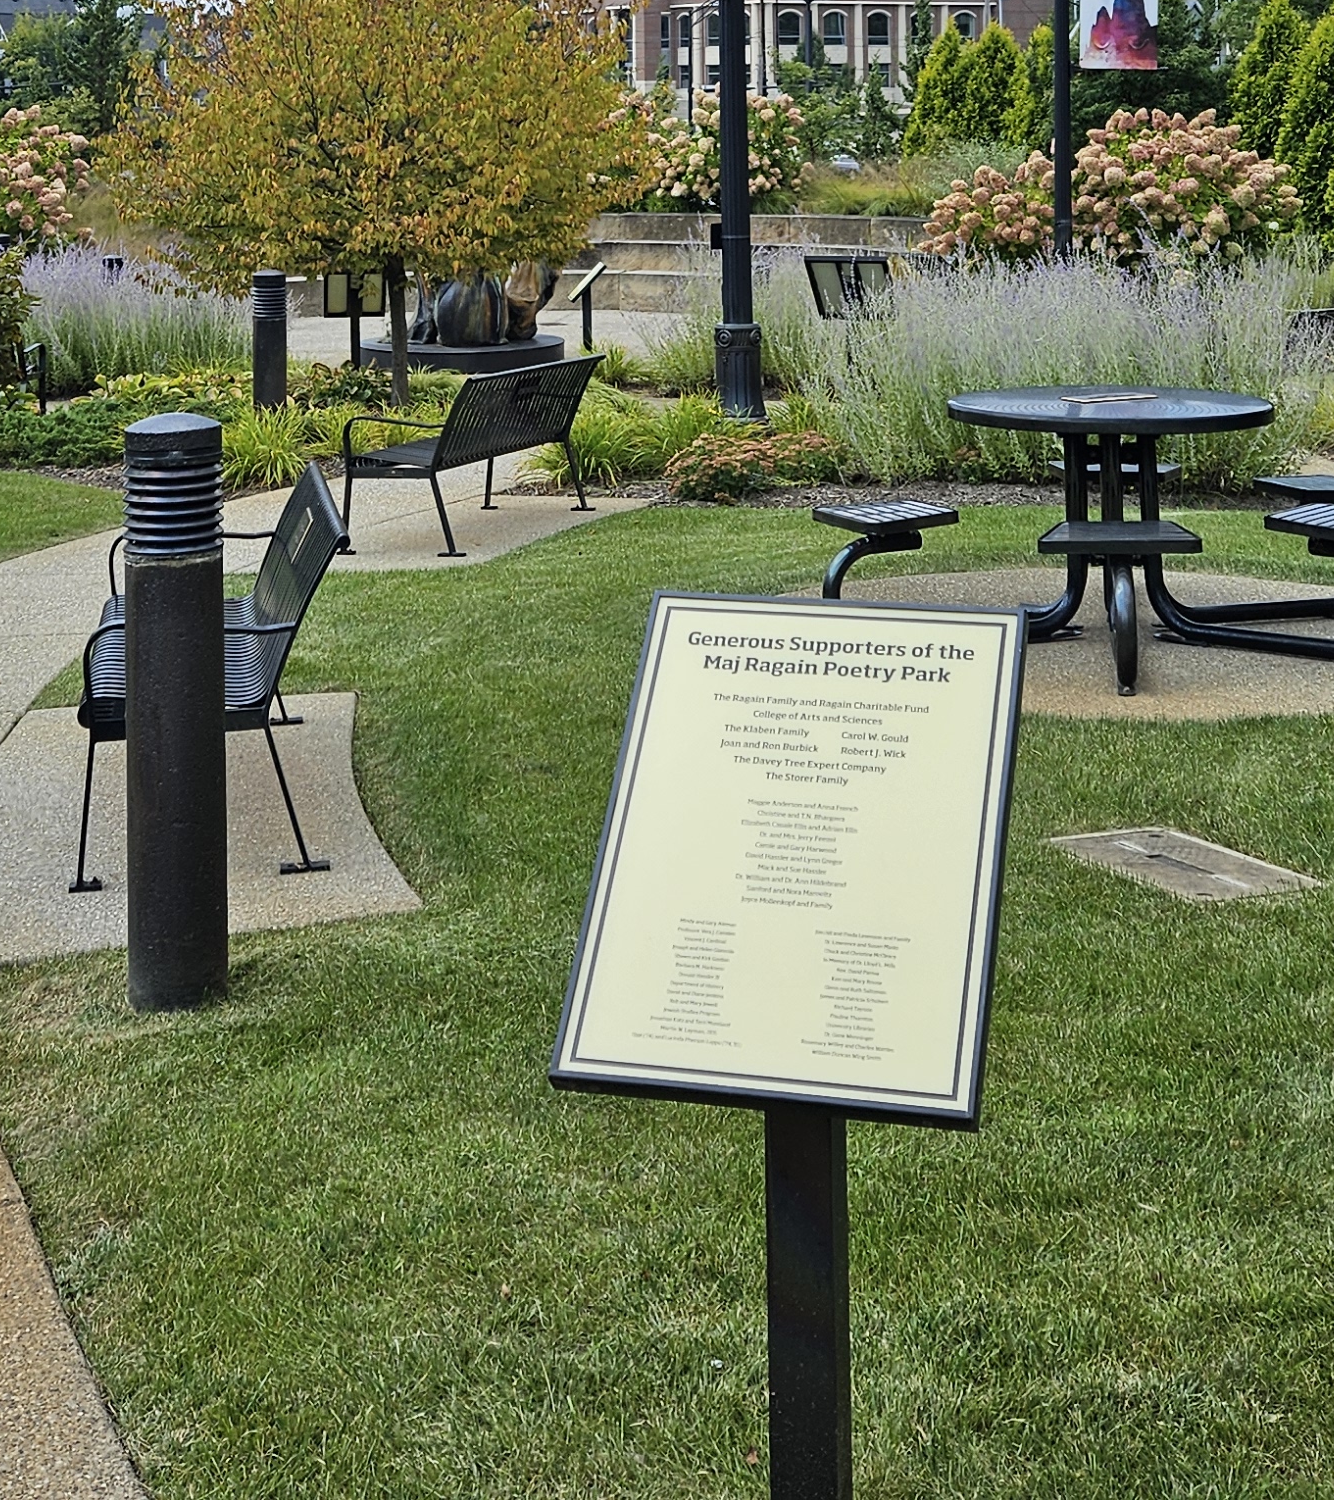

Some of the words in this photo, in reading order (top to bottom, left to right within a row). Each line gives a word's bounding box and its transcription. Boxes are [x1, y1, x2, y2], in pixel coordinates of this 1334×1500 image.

[688, 631, 785, 650] Generous
[788, 636, 906, 656] Supporters
[911, 643, 934, 658] of
[938, 644, 974, 660] the
[703, 654, 741, 674] Maj
[743, 657, 817, 676] Ragain
[822, 661, 896, 682] Poetry
[900, 665, 950, 682] Park
[713, 692, 731, 701] The
[731, 693, 764, 704] Ragain
[766, 695, 798, 707] Family
[798, 698, 817, 706] and
[818, 699, 852, 709] Ragain
[853, 701, 903, 712] Charitable
[903, 704, 929, 713] Fund
[752, 709, 787, 720] College
[788, 711, 798, 720] of
[799, 712, 820, 721] Arts
[822, 714, 840, 723] and
[841, 715, 882, 725] Sciences
[724, 723, 741, 732] The
[742, 724, 775, 734] Klaben
[777, 726, 809, 738] Family
[841, 731, 866, 740] Carol
[867, 732, 879, 741] W.
[880, 733, 909, 743] Gould
[719, 738, 741, 748] Joan
[742, 740, 760, 749] and
[761, 741, 780, 750] Ron
[782, 742, 817, 752] Burbick
[840, 746, 873, 756] Robert
[873, 748, 881, 758] J.
[883, 748, 906, 758] Wick
[733, 755, 751, 763] The
[751, 756, 782, 767] Davey
[784, 758, 805, 767] Tree
[806, 759, 839, 770] Expert
[841, 762, 886, 775] Company
[765, 771, 783, 780] The
[784, 772, 814, 782] Storer
[815, 774, 848, 787] Family
[756, 809, 786, 817] Christine
[809, 900, 832, 910] Family
